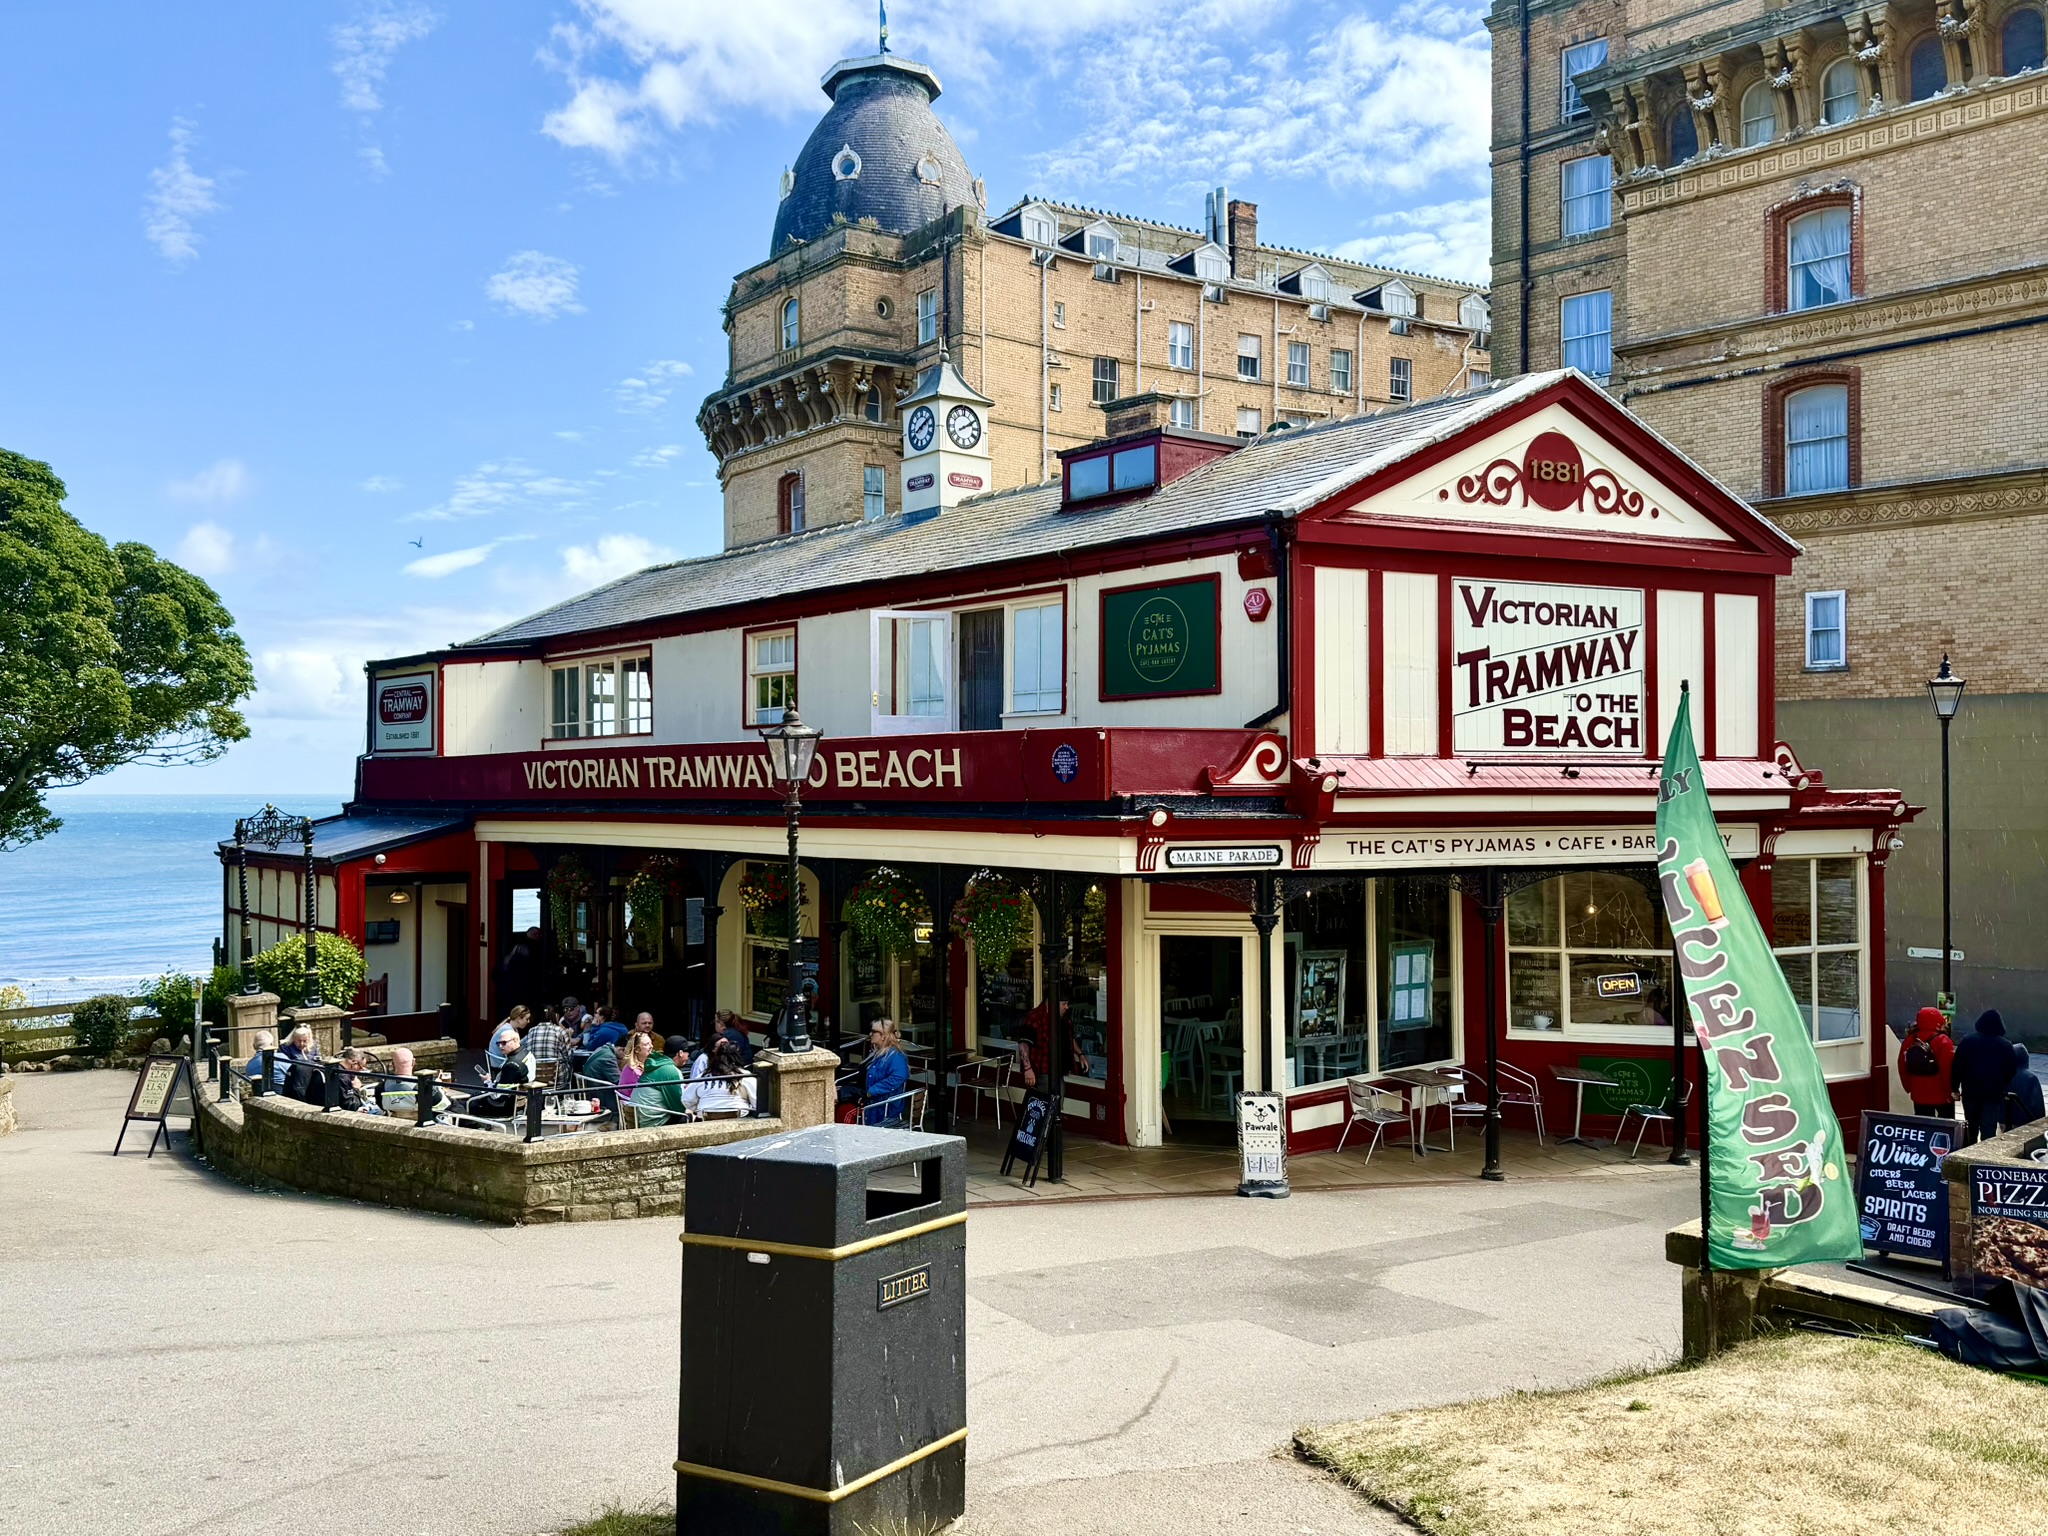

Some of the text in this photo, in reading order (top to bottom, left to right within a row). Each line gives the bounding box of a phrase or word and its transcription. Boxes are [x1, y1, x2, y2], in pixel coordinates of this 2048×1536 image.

[1531, 459, 1579, 483] 1881
[1458, 585, 1618, 629] VICTORIAN
[1142, 627, 1174, 641] CAT'S
[1136, 641, 1180, 656] PYJAMAS
[1457, 629, 1639, 707] TRAMWAY
[393, 690, 413, 698] CENTRAL
[382, 696, 424, 713] TRAMWAY
[1563, 693, 1639, 714] TO THE
[393, 712, 412, 720] COMPANY
[386, 732, 410, 740] ESTABLISHED
[1502, 708, 1640, 749] BEACH
[522, 757, 639, 790] VICTORIAN
[643, 753, 775, 789] TRAMWAY
[835, 748, 963, 789] BEACH
[1346, 835, 1656, 855] THE CAT'S PYJAMAS CAFE BAR
[1176, 850, 1273, 863] MARINE PARADE
[1602, 979, 1635, 991] OPEN
[1605, 1087, 1645, 1096] PYJAMAS
[1620, 1079, 1639, 1088] AT'S
[1244, 1122, 1278, 1132] Pawvale
[1874, 1124, 1926, 1142] COFFEE
[1868, 1138, 1929, 1168] Wines
[1870, 1168, 1902, 1179] CIDERS
[1885, 1179, 1915, 1190] BEERS
[1902, 1190, 1937, 1201] LAGERS
[1976, 1181, 2048, 1208] PIZZ
[1864, 1195, 1928, 1223] SPIRITS
[1978, 1206, 2000, 1215] NOW
[2002, 1208, 2031, 1218] BEING
[1887, 1222, 1936, 1240] DRAFT BEERS
[1889, 1233, 1932, 1249] AND CIDERS
[882, 1271, 929, 1302] LITTER
